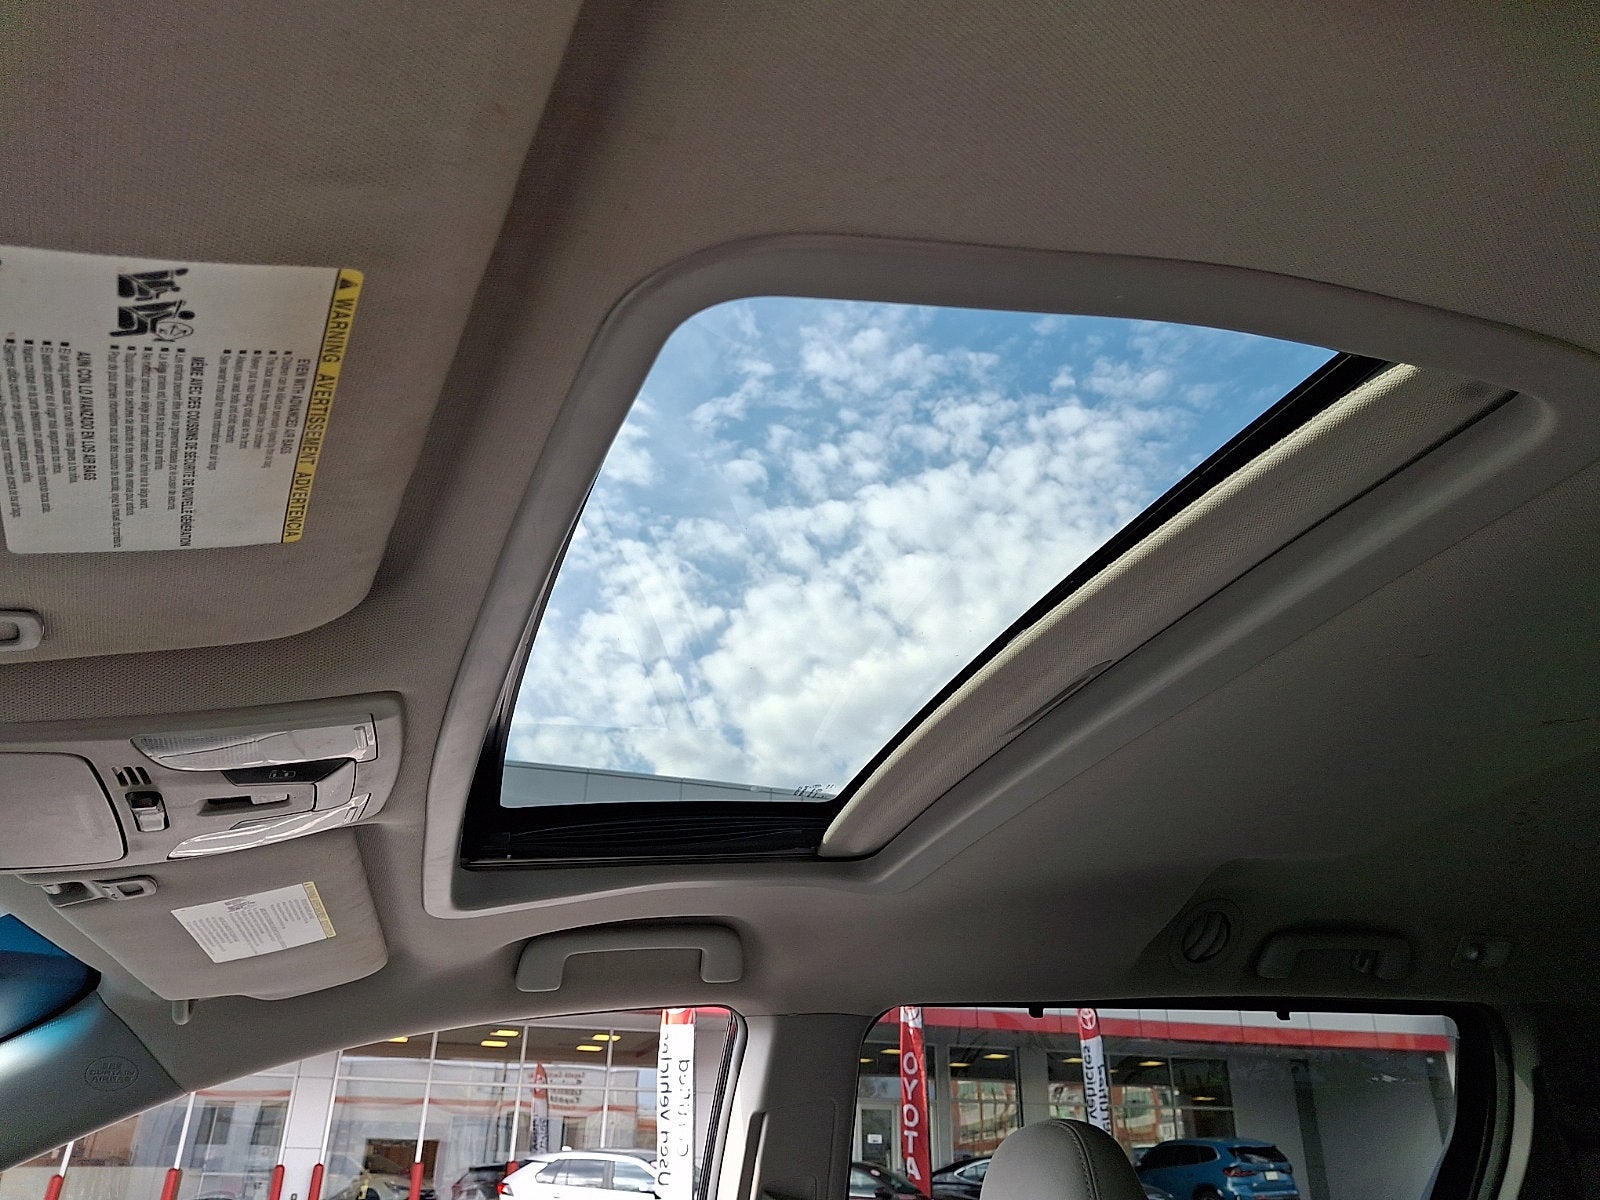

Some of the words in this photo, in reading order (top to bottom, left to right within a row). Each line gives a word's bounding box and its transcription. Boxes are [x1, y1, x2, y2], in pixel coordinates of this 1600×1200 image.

[322, 298, 355, 363] WARNING
[76, 351, 91, 366] AUN
[189, 356, 208, 376] MÊME
[295, 358, 310, 376] EVEN
[76, 368, 92, 383] CON
[78, 385, 93, 395] LO
[188, 377, 202, 394] AVEC
[291, 378, 306, 393] WITH
[187, 396, 201, 409] DES
[285, 395, 303, 427] ADVANCED
[78, 396, 95, 429] AVANZADO
[299, 374, 335, 465] AVERTISSEMENT
[184, 410, 201, 440] COUSSINS
[283, 429, 296, 437] AIR
[80, 431, 94, 439] EN
[81, 440, 95, 452] LOS
[279, 439, 294, 454] BAGS
[82, 454, 96, 463] AIR
[181, 451, 199, 477] SÉCURITÉ
[82, 465, 96, 480] BAGS
[181, 478, 195, 486] DE
[179, 486, 195, 513] NOUVELLE
[285, 472, 312, 537] ADVERTENCIA
[177, 514, 195, 546] GÉNÉRATION
[901, 1028, 921, 1181] OYOTA
